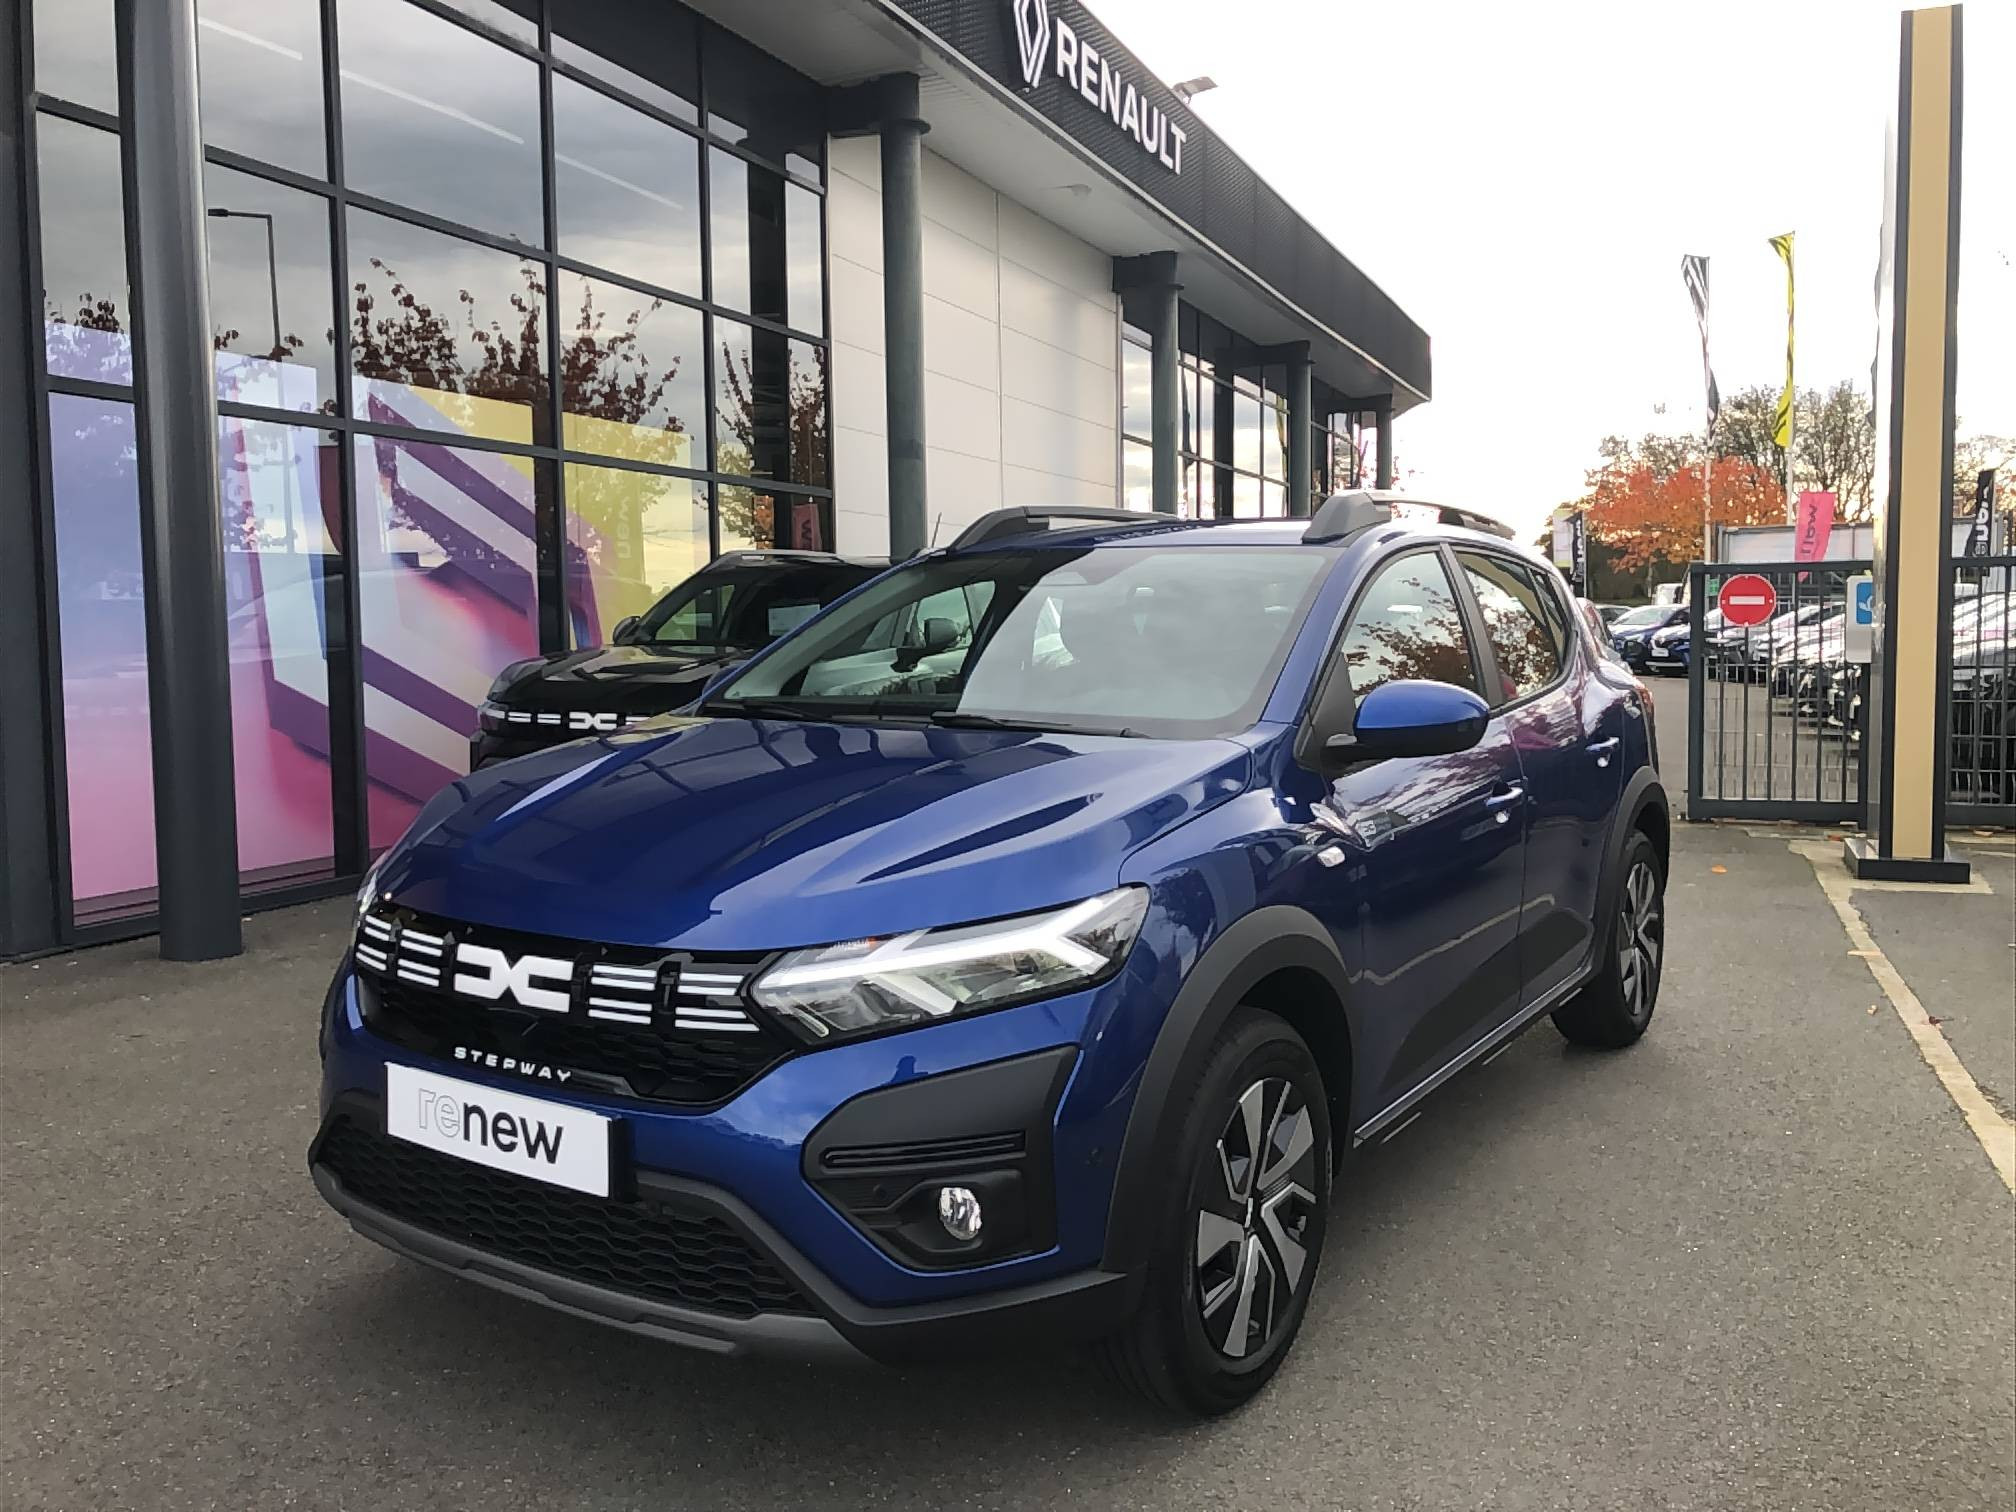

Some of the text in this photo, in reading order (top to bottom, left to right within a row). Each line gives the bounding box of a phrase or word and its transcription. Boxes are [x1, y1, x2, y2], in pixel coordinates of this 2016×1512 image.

[1057, 17, 1187, 175] RENAULT
[454, 1046, 571, 1082] STEPWAY
[418, 1088, 564, 1164] renew
